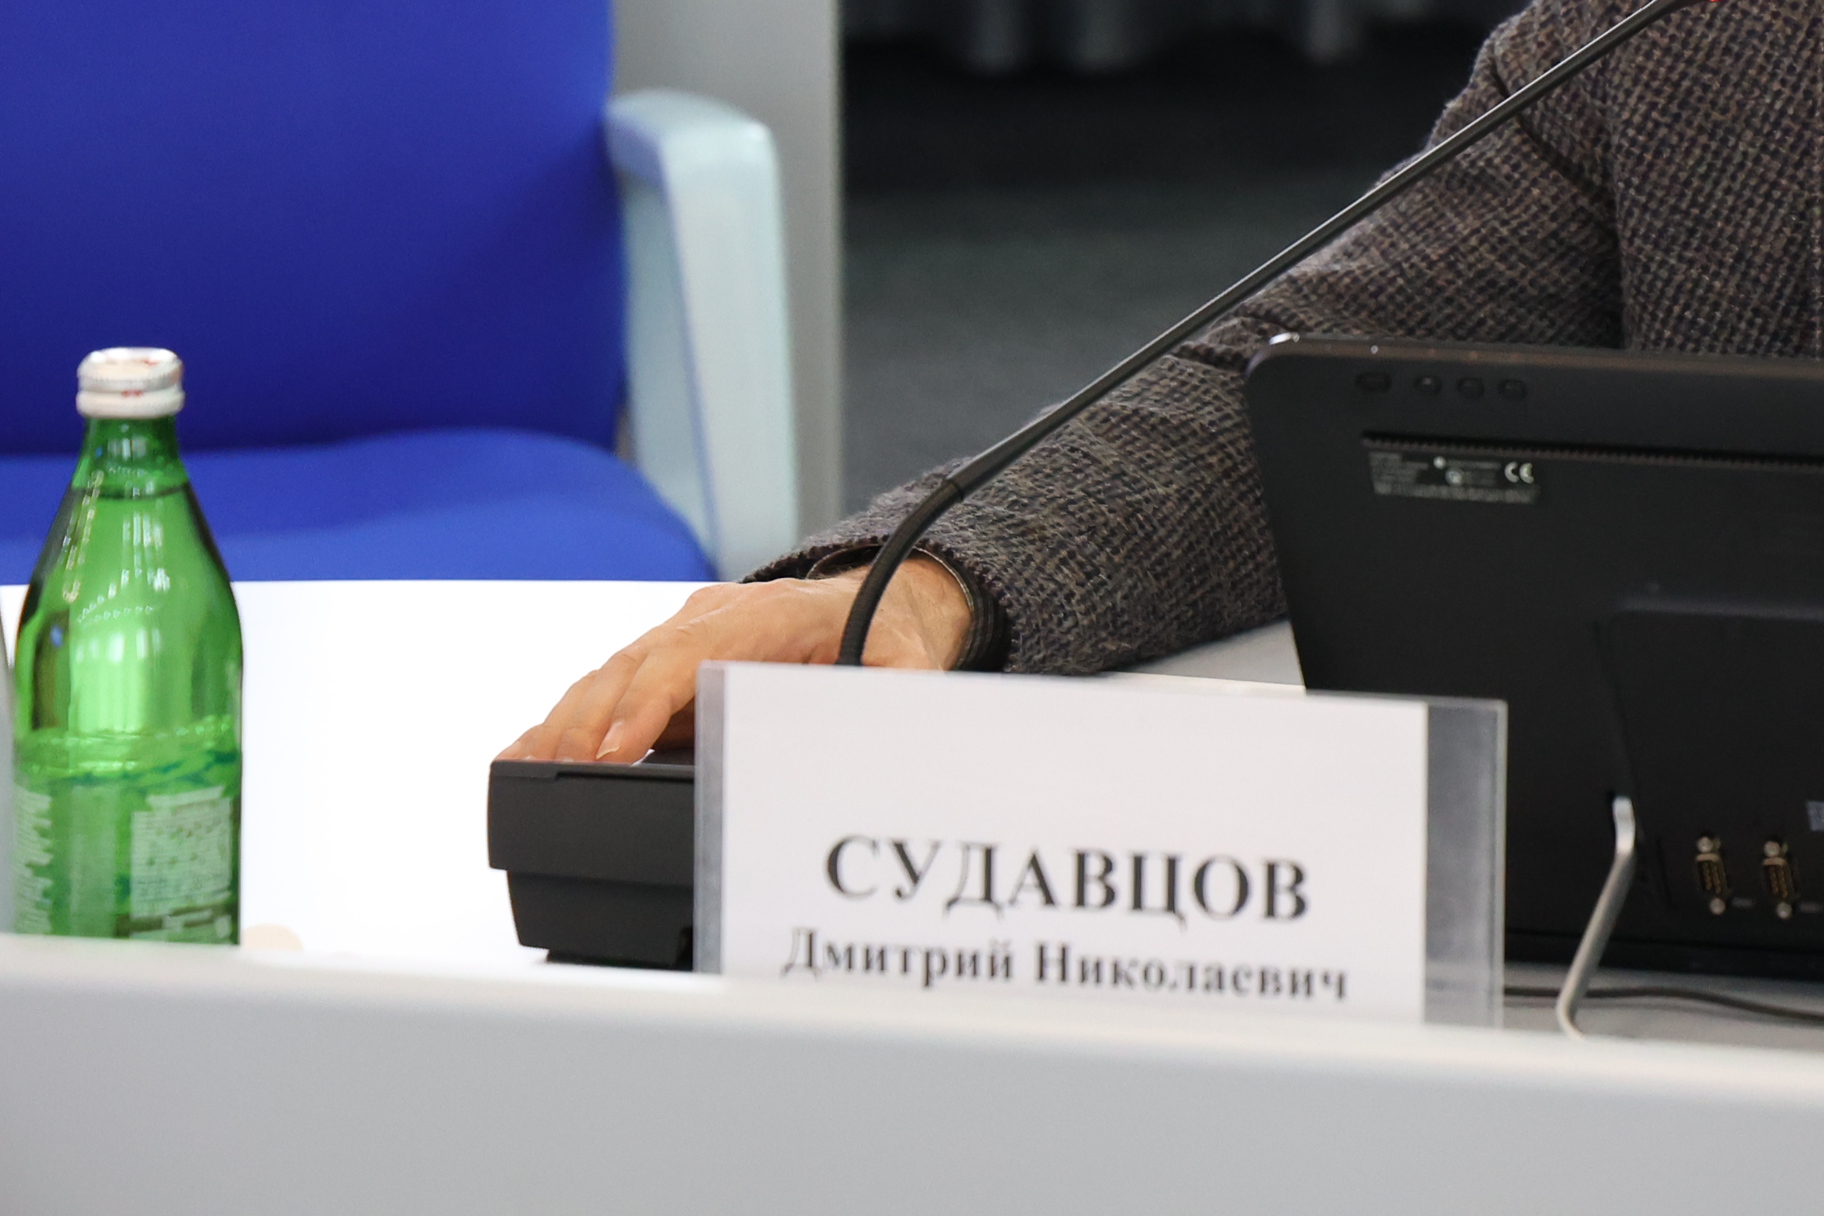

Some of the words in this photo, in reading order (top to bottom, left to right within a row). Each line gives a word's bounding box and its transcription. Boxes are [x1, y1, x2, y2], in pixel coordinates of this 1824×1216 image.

[824, 834, 1309, 928] СУДАВЦОВ
[780, 927, 1013, 989] Дмитрий
[1035, 941, 1347, 1001] Николаевич
